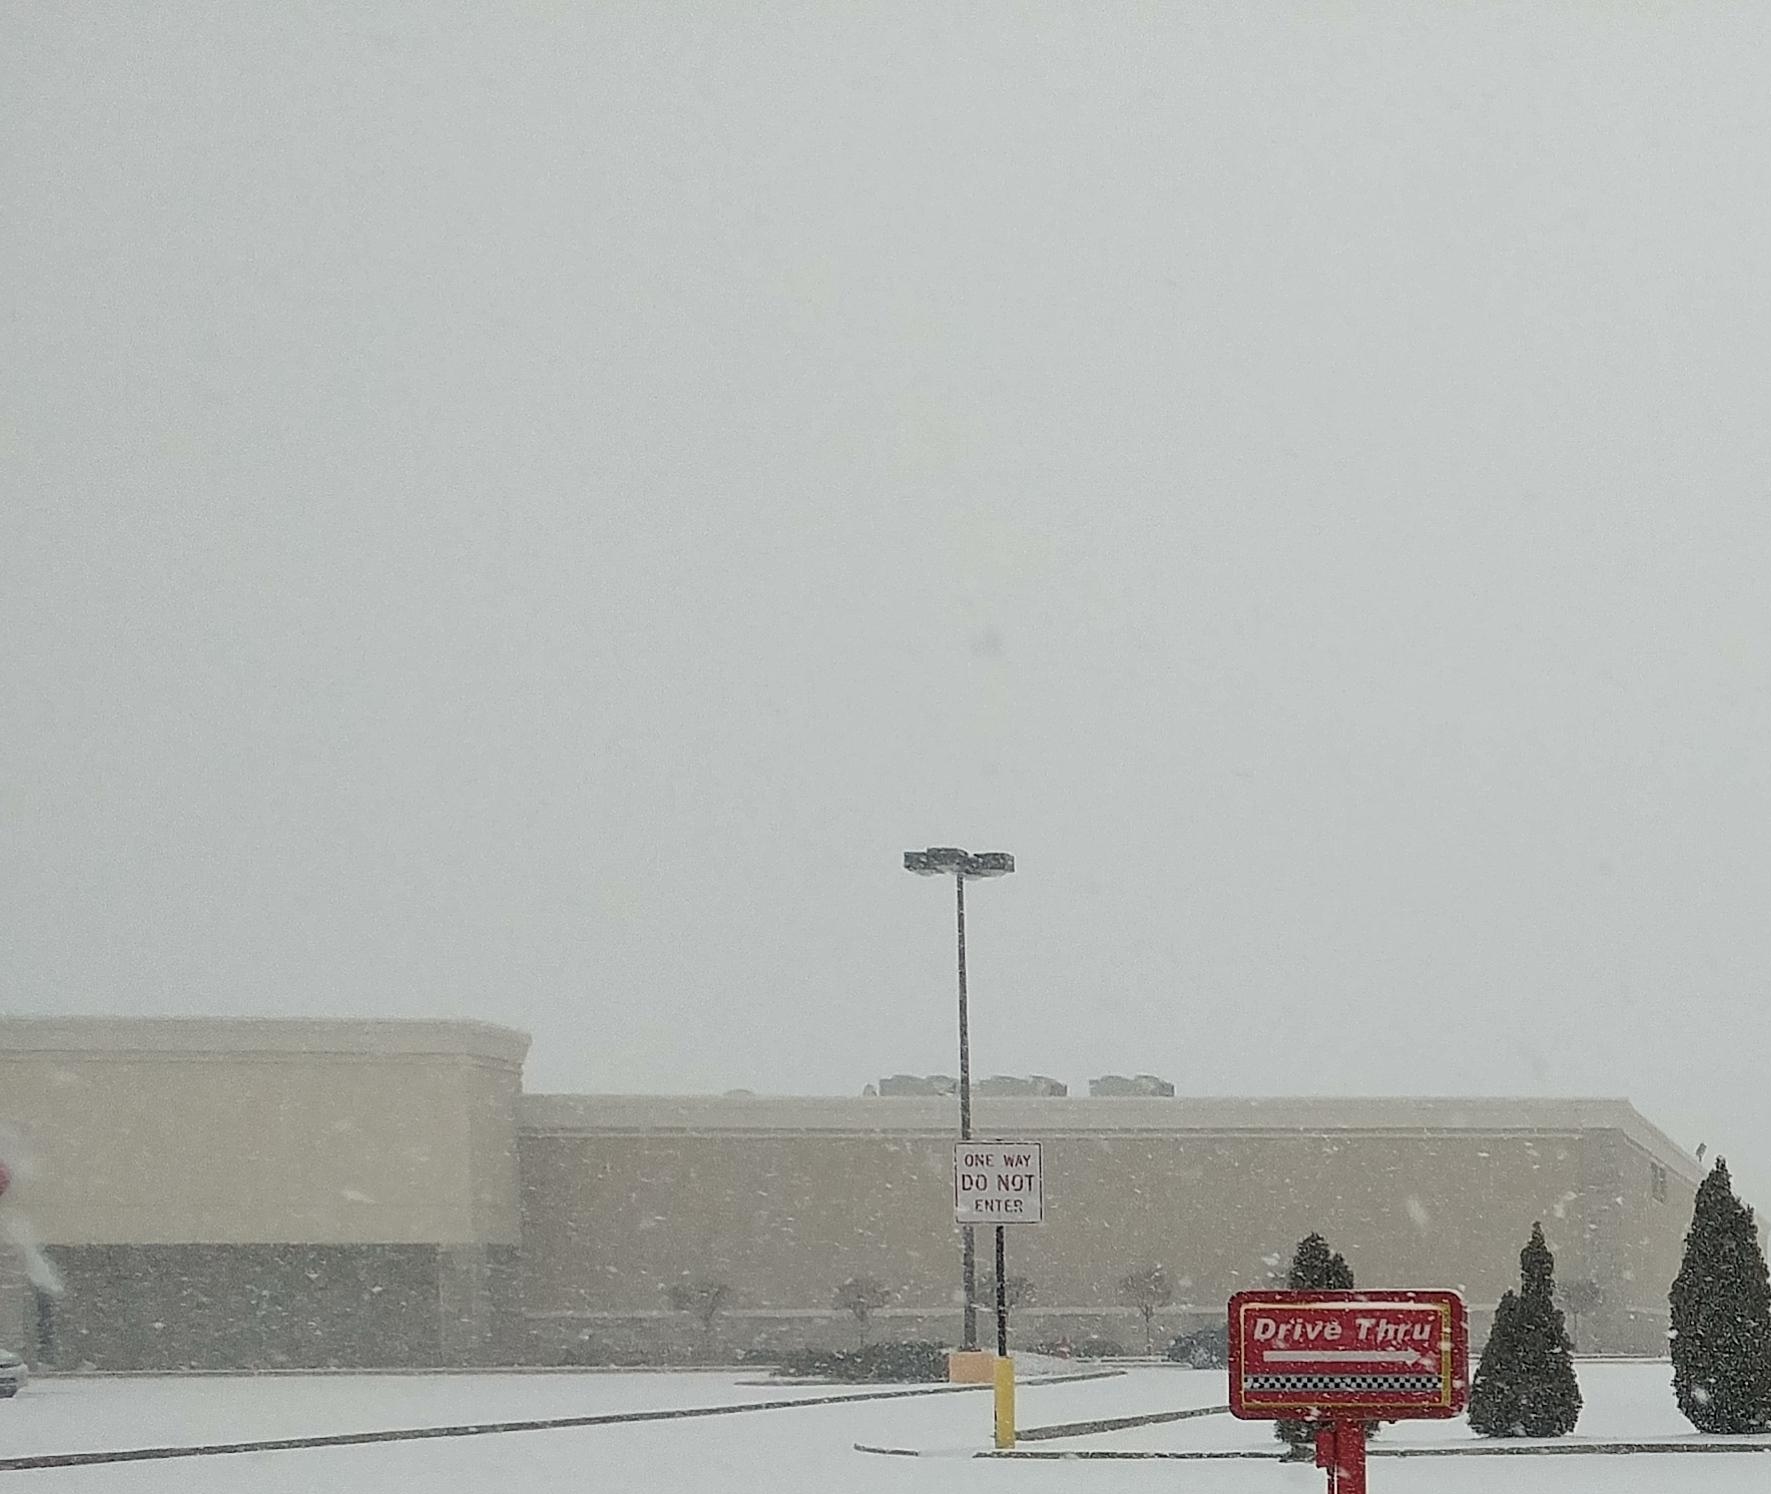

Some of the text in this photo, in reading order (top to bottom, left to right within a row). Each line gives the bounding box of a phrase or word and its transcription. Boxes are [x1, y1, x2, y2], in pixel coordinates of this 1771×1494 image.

[964, 1153, 1031, 1168] ONE WAY
[961, 1173, 1036, 1192] DO NOT
[974, 1199, 1024, 1213] ENTER
[1253, 1317, 1433, 1342] Drive Thru
